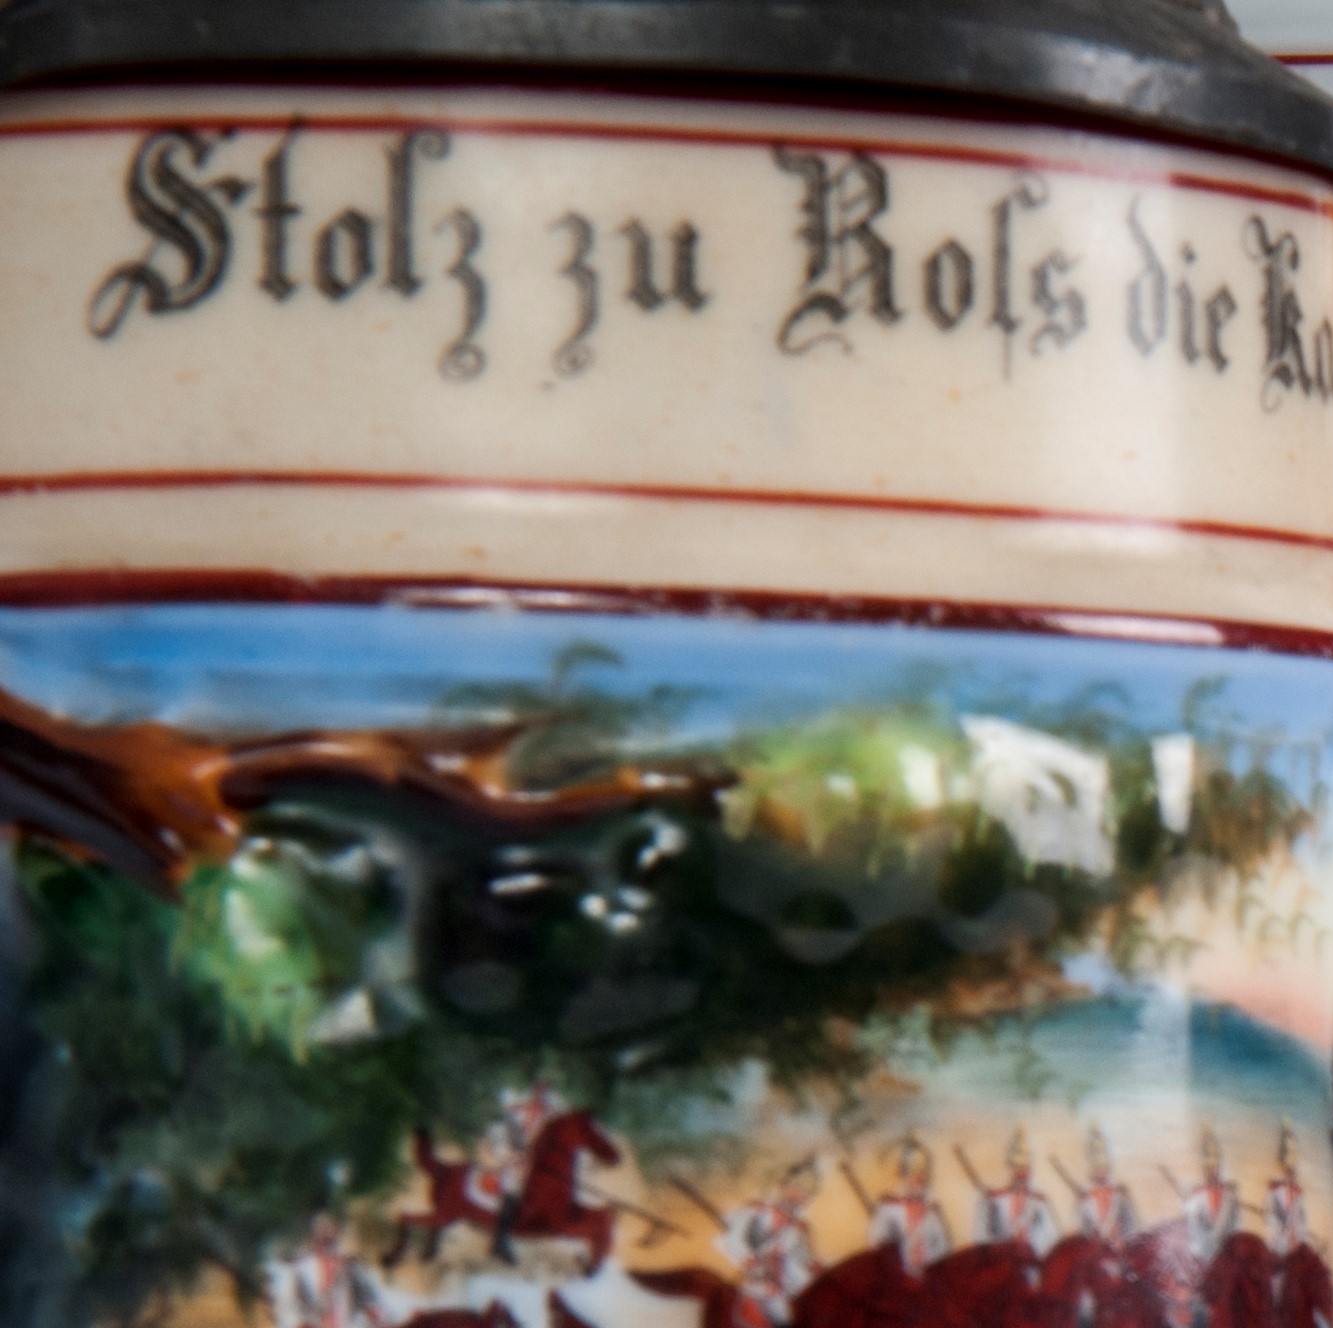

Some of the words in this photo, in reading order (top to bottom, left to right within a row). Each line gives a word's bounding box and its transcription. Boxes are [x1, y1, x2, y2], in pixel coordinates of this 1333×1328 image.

[87, 112, 488, 382] Stolz
[548, 210, 706, 379] zu
[1124, 195, 1240, 375] die
